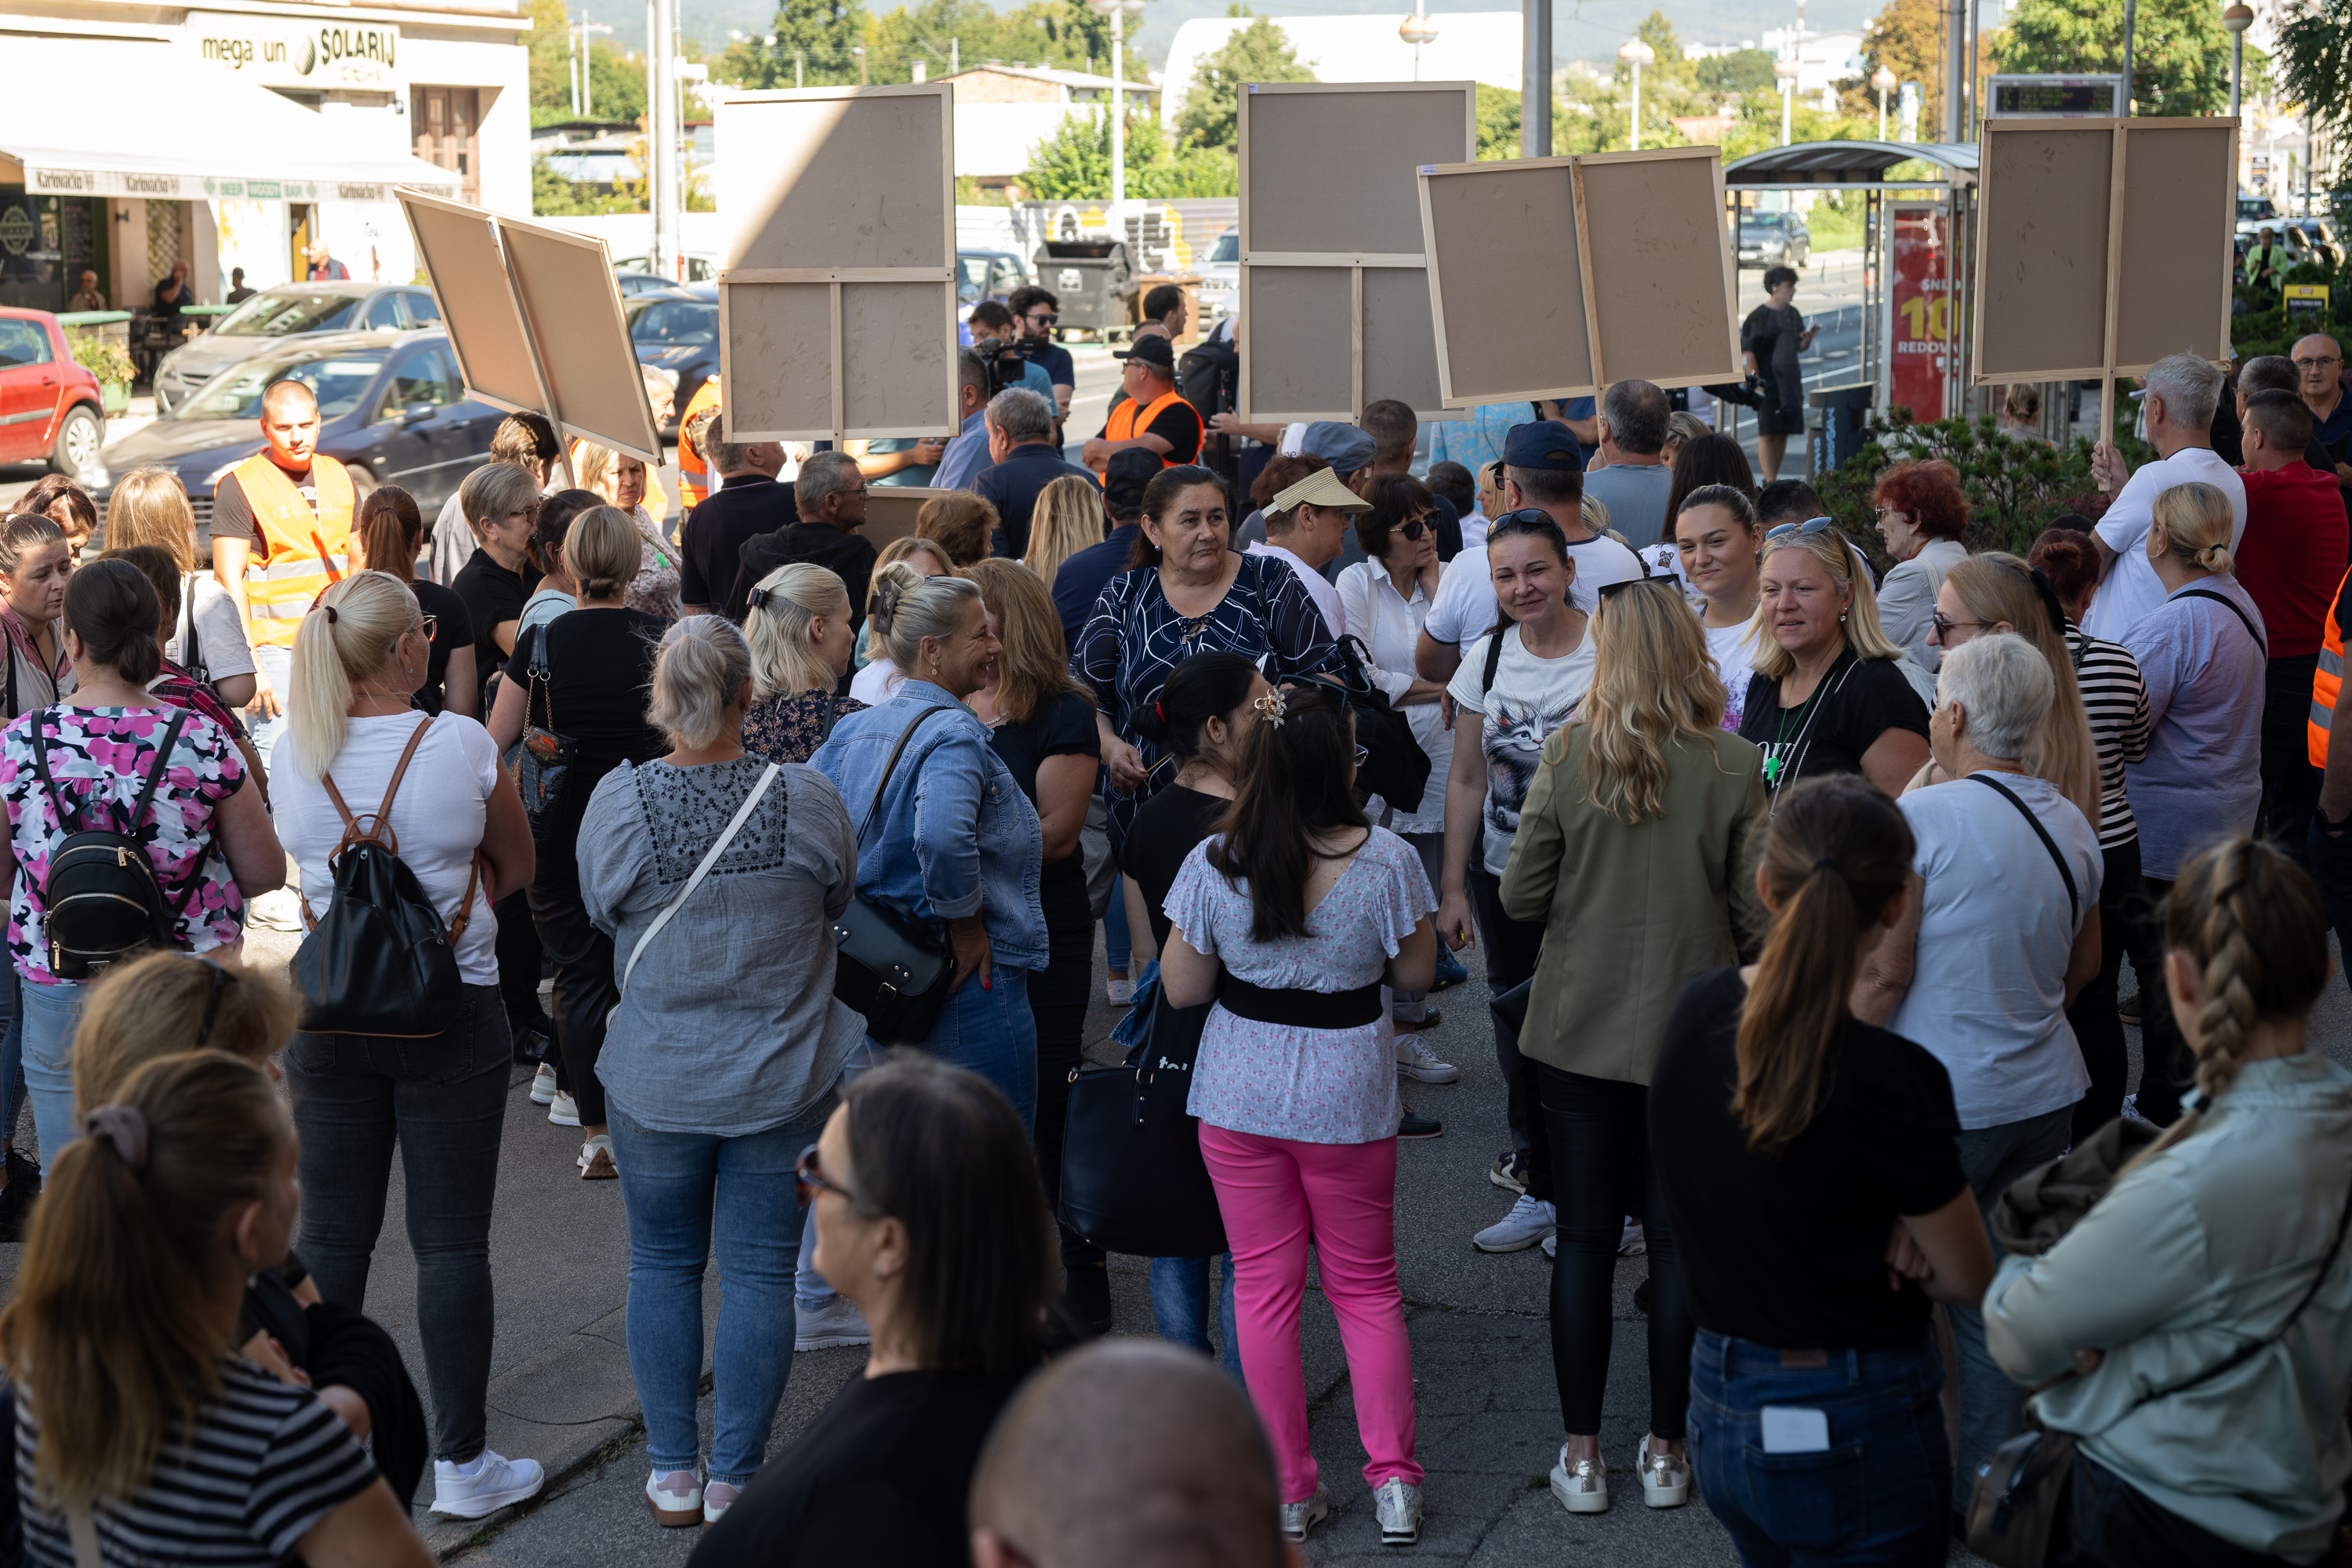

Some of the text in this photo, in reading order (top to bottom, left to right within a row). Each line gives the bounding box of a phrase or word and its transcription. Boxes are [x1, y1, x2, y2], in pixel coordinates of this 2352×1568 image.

[202, 38, 253, 69] mega
[321, 27, 394, 69] SOLARIJ
[220, 182, 245, 196] BEER
[284, 184, 302, 197] BAR
